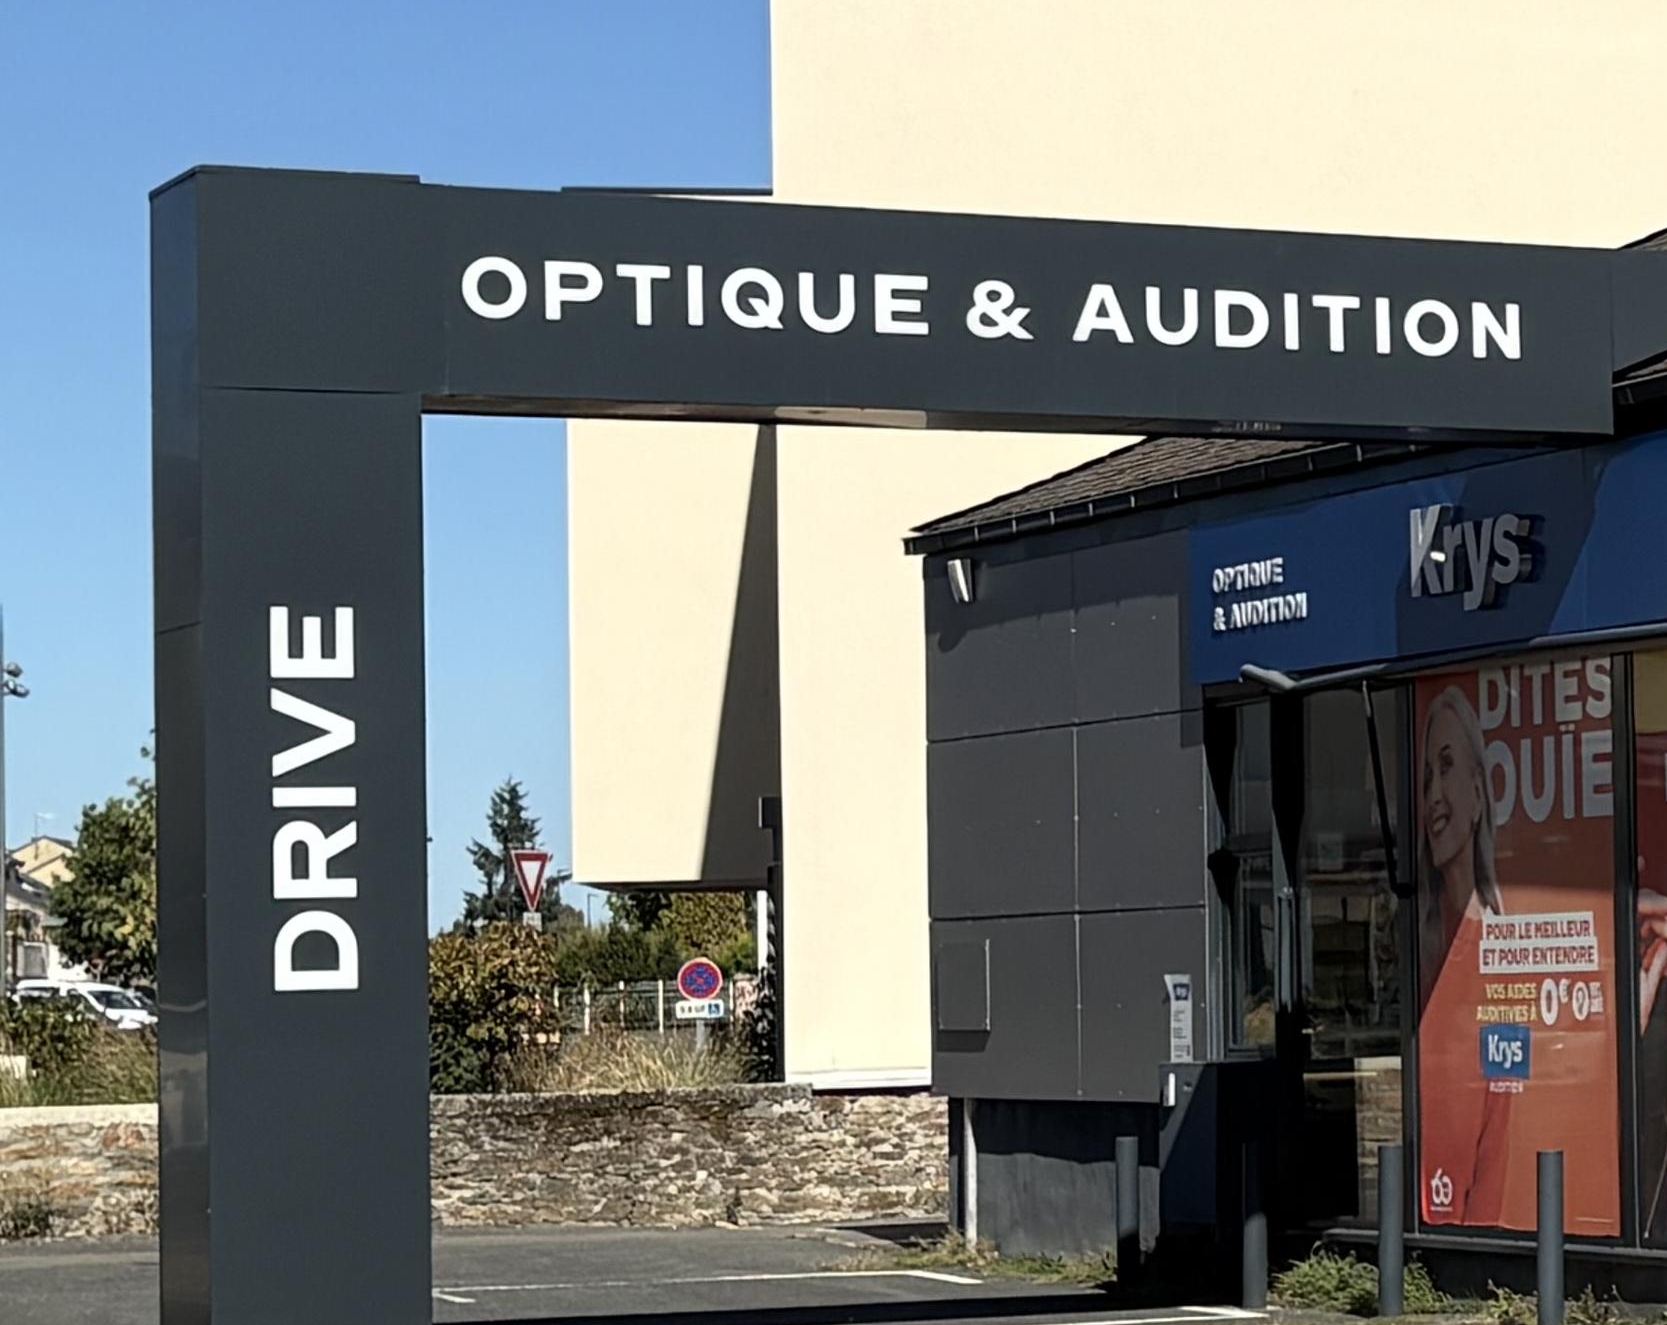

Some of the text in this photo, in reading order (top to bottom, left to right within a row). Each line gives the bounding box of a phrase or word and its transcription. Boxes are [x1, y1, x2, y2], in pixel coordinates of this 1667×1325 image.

[461, 255, 1522, 361] OPTIQUE & AUDITION
[1212, 557, 1284, 594] OPTIQUE
[1409, 502, 1524, 612] Krys
[1213, 591, 1309, 632] & AUDITION
[1478, 656, 1613, 731] DITES
[1485, 723, 1615, 827] OUÏE
[268, 605, 360, 992] DRIVE
[1485, 919, 1592, 941] POUR LE MEILLEUR
[1482, 945, 1596, 966] ET POUR ENTENDRE
[1485, 982, 1537, 1000] VOS AIDES
[1476, 1005, 1529, 1023] AUDITIVES
[1487, 1034, 1524, 1069] Krys
